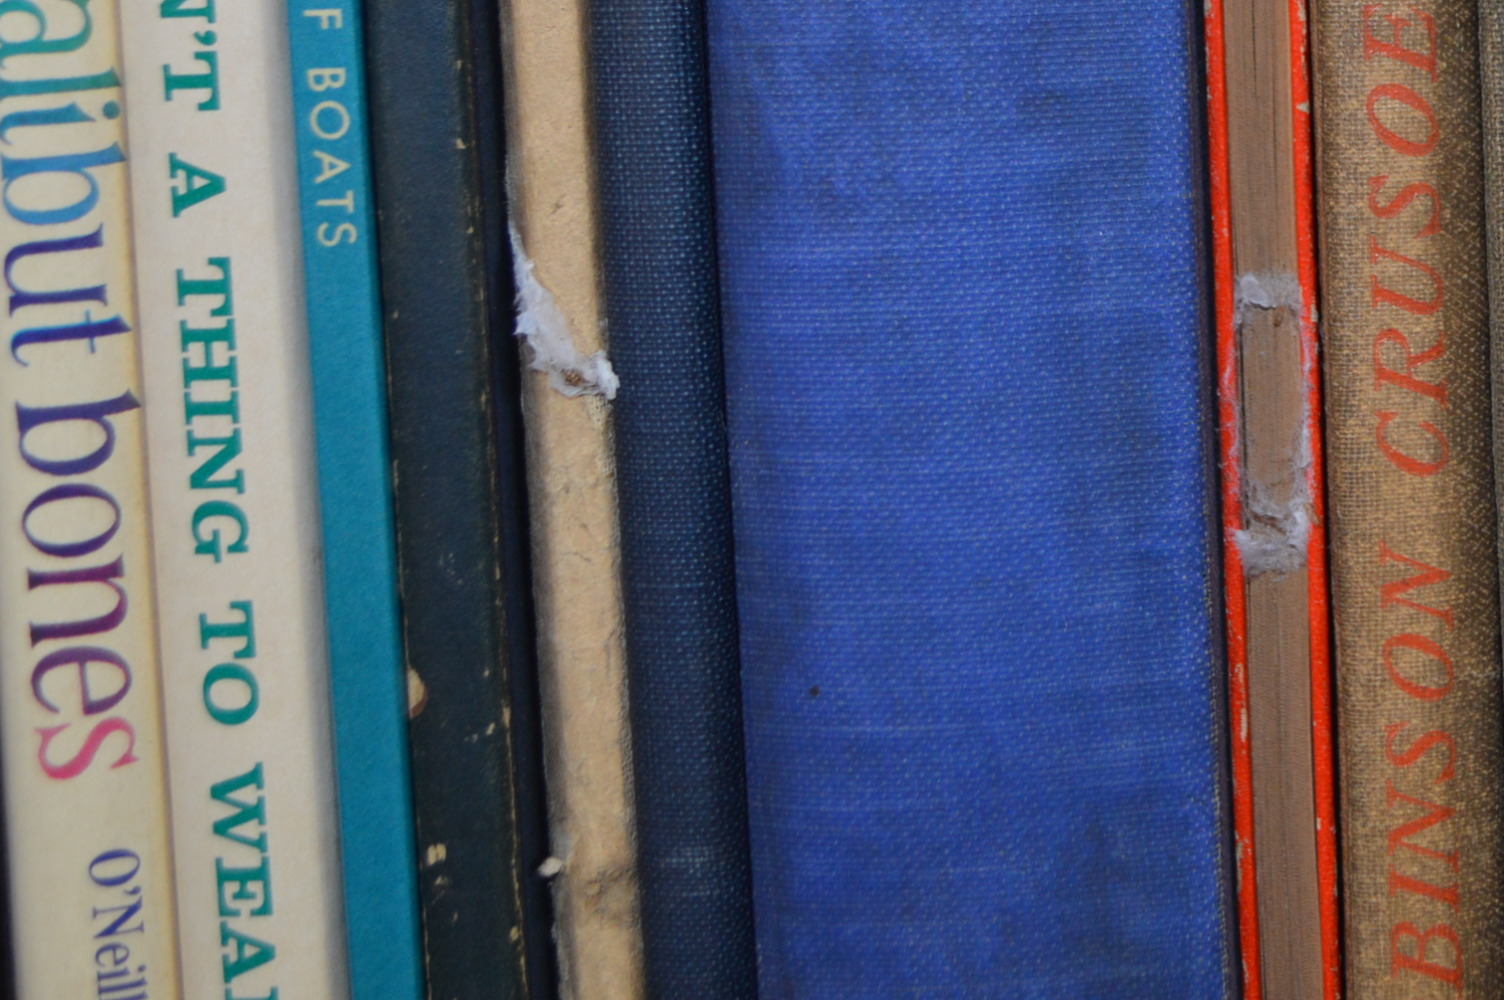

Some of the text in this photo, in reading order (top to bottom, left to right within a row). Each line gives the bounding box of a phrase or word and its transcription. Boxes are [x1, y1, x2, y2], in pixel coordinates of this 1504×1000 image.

[168, 151, 228, 218] A
[305, 67, 359, 249] BOATS
[175, 256, 250, 563] THING
[1363, 1, 1464, 1000] BINSON CRUSOE
[17, 389, 142, 781] bones
[198, 600, 261, 727] TO
[210, 761, 279, 1000] WEA
